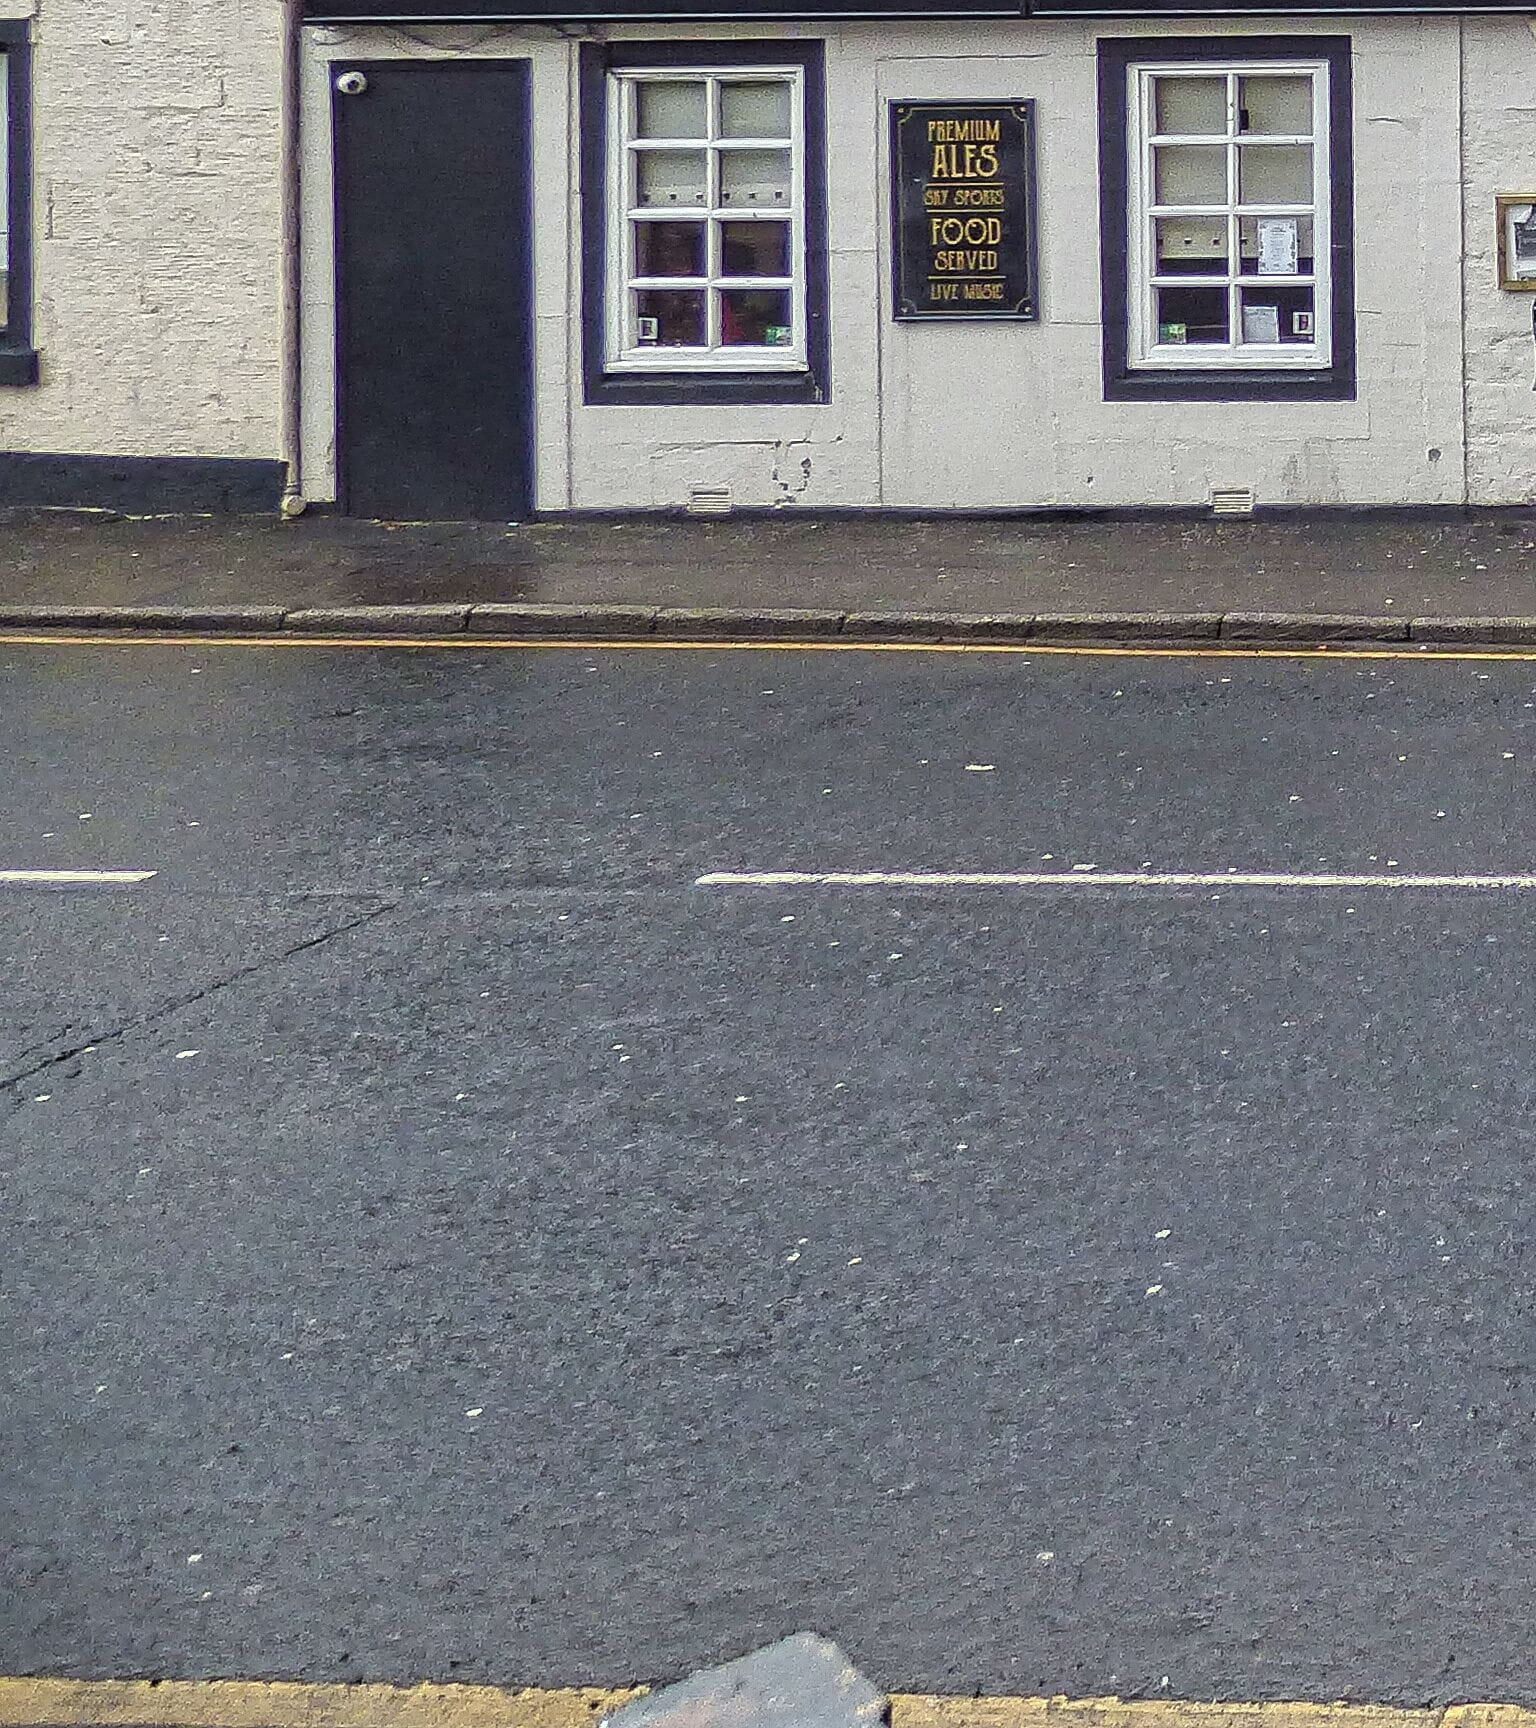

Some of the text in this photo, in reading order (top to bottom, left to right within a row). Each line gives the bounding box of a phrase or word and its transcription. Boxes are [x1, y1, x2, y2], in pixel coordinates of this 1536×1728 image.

[928, 120, 1000, 142] PREMIUM
[932, 143, 1000, 179] ALES
[954, 190, 1004, 206] SPORTS
[931, 218, 1001, 245] FOOD
[935, 250, 998, 271] SERVED
[930, 283, 1004, 301] LIVE MUSIC
